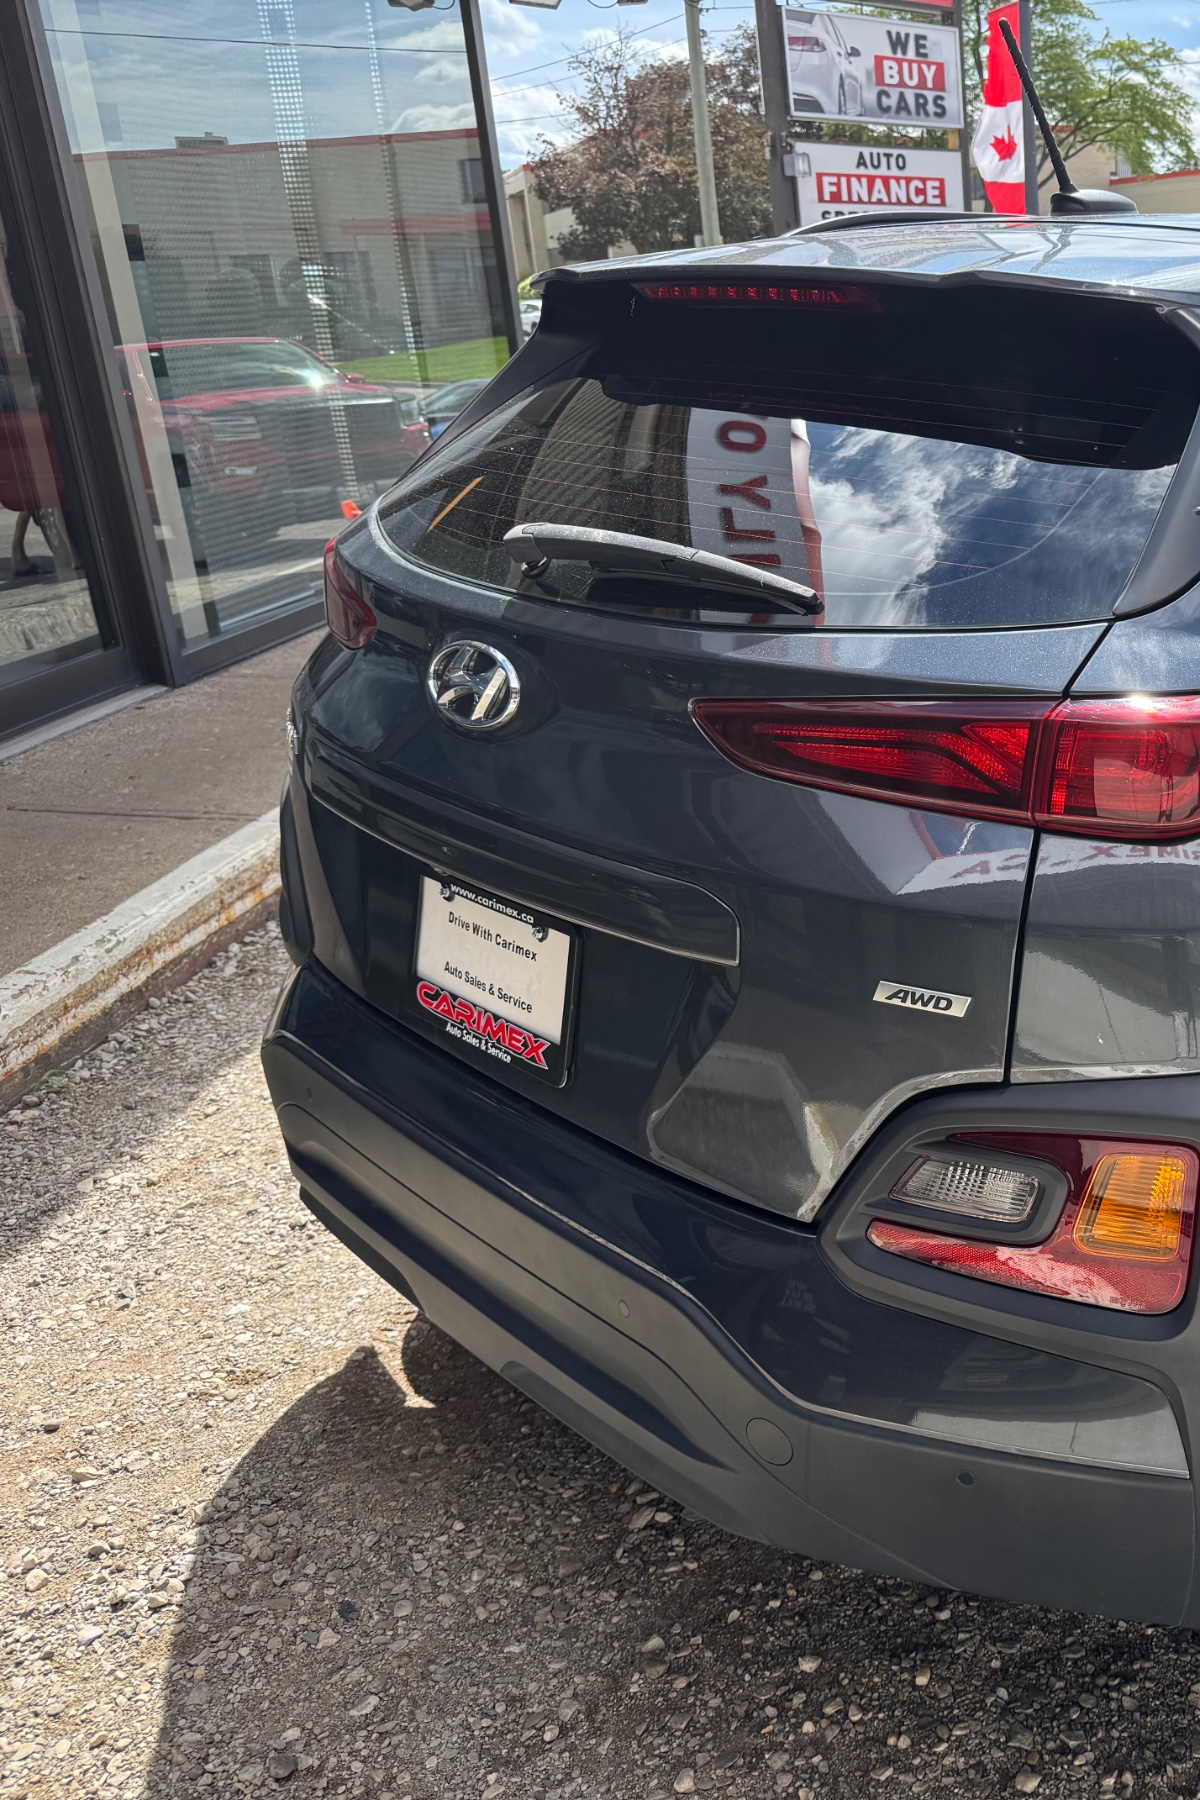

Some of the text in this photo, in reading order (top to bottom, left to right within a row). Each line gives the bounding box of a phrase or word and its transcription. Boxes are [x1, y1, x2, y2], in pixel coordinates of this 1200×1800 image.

[886, 29, 929, 59] WE
[882, 59, 938, 90] BUY
[876, 89, 947, 119] CARS
[856, 151, 907, 171] AUTO
[821, 175, 942, 204] FINANCE
[450, 883, 534, 924] www.carimex.ca
[448, 911, 538, 962] Drive With Carimex
[444, 961, 533, 1014] Auto Sales & Service
[884, 988, 954, 1012] AWD
[417, 980, 551, 1070] CARIMEX
[446, 1022, 461, 1038] Auto
[462, 1029, 480, 1048] Sales
[487, 1041, 511, 1064] Service
